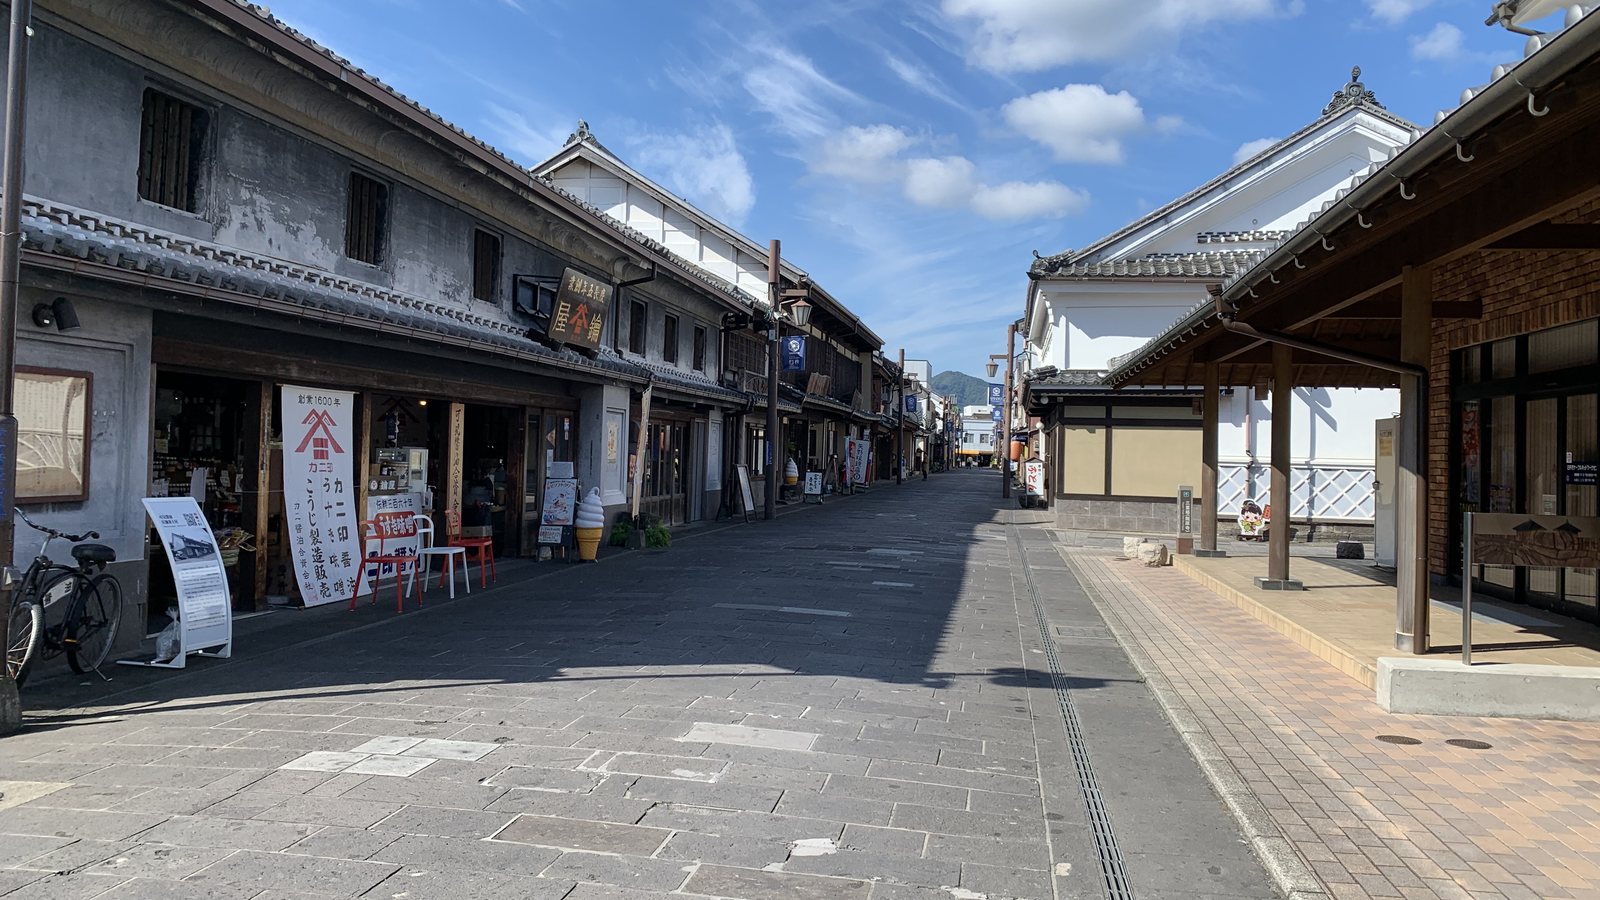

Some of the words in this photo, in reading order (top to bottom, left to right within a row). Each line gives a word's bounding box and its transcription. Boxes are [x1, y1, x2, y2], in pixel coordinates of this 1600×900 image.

[298, 394, 341, 407] 創業1600年
[379, 514, 414, 536] うすき味噌
